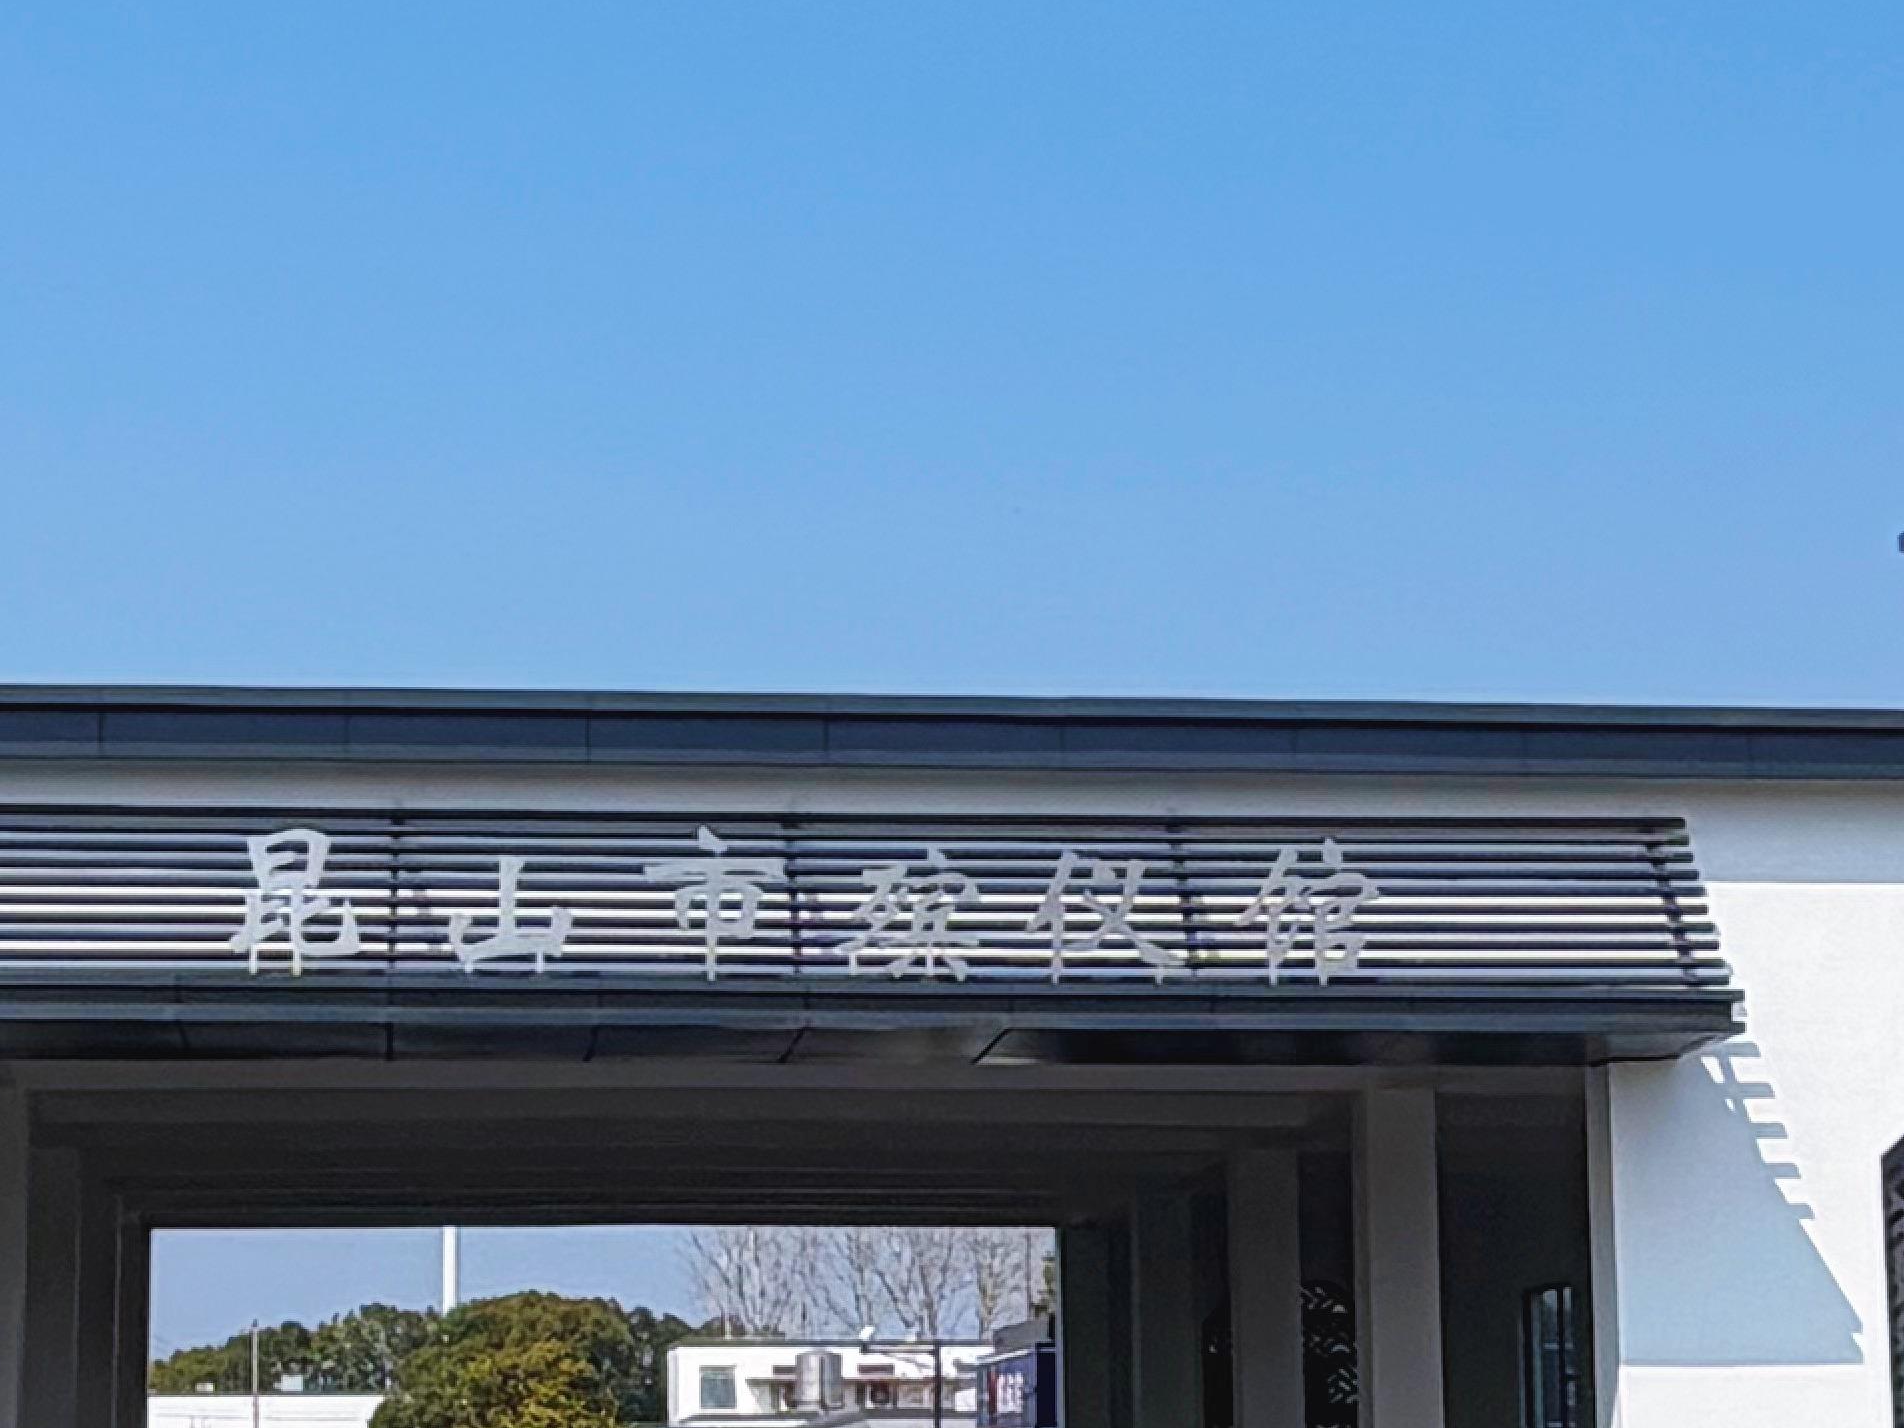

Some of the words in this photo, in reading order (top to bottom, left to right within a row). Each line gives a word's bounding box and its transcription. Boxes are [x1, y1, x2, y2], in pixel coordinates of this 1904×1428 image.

[228, 826, 1381, 984] 昆山市殡仪馆
